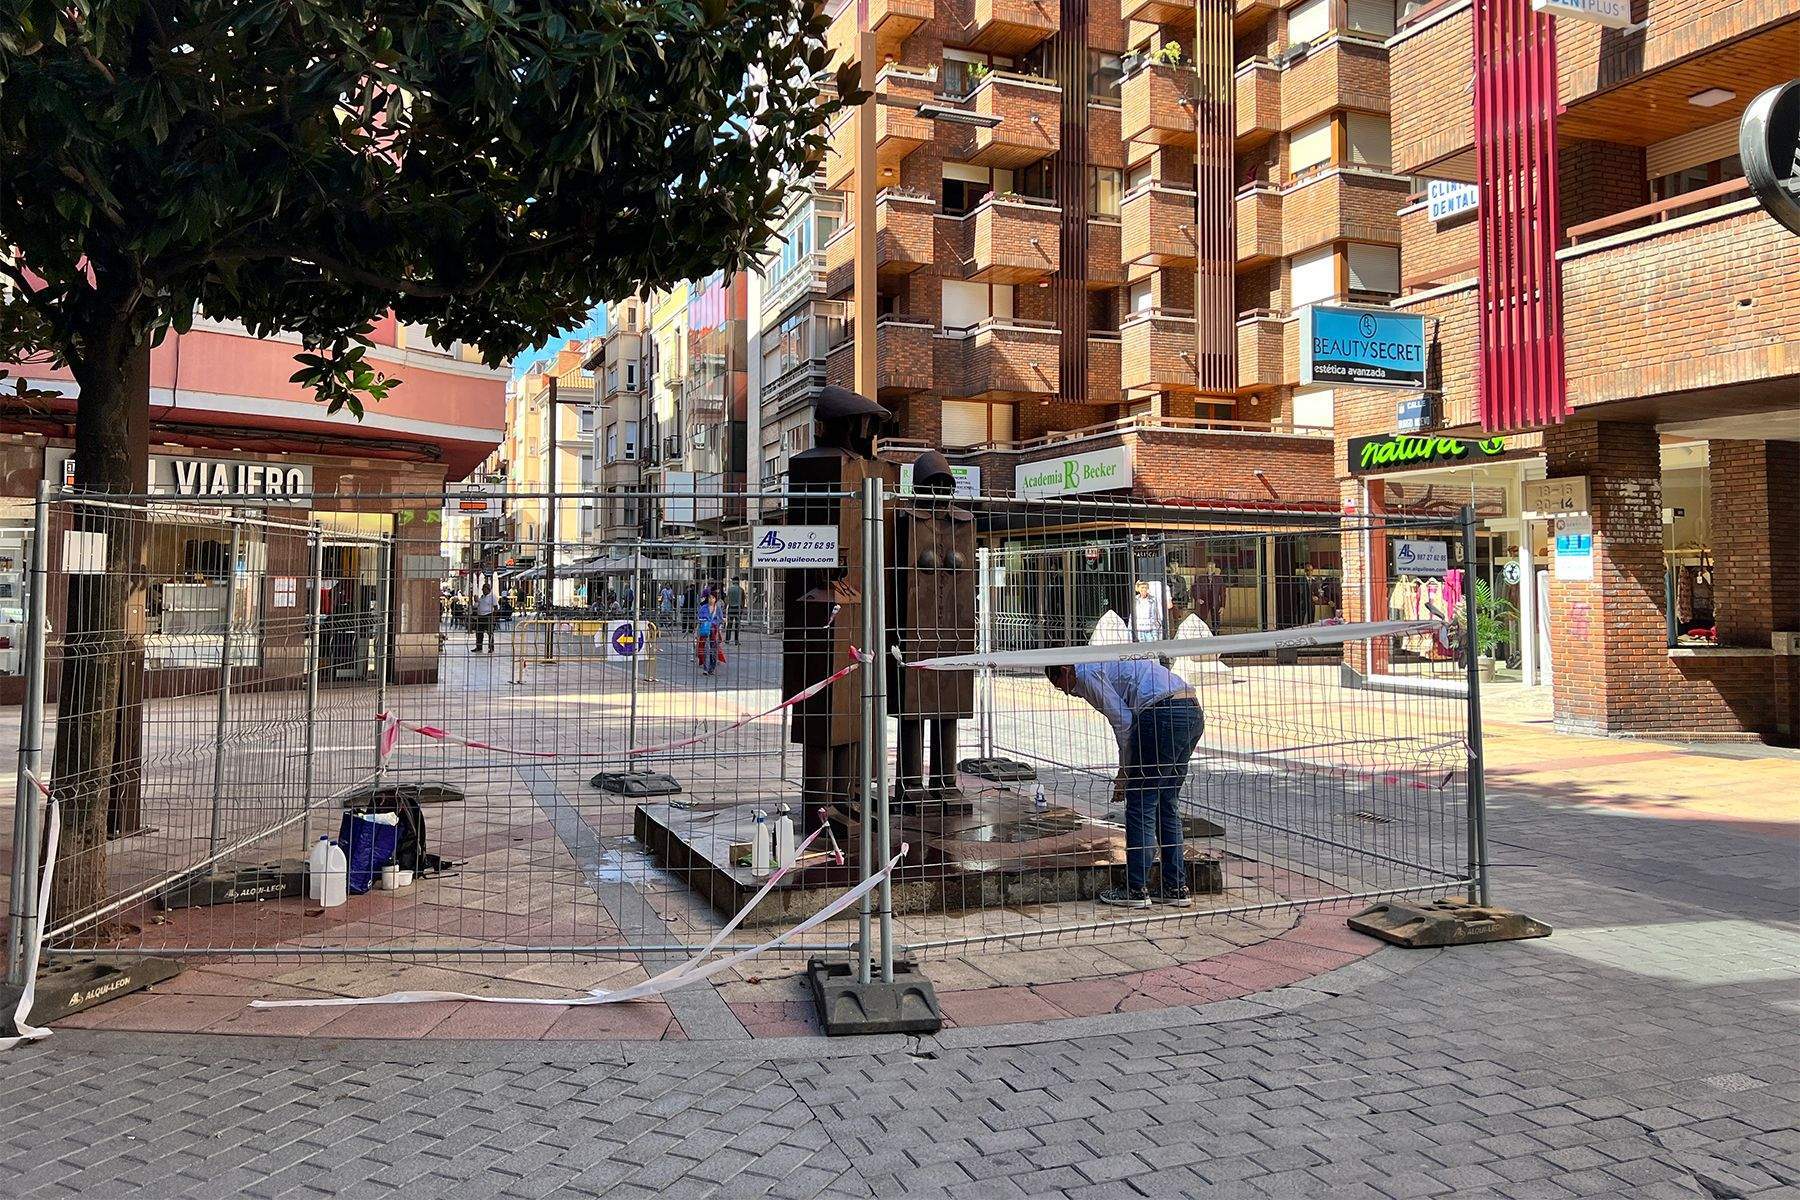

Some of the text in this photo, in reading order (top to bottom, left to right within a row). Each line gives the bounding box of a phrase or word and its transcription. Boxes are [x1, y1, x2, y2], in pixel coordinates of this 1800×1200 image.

[1433, 190, 1477, 217] DENTAL
[1313, 337, 1422, 361] BEAUTYSECRET
[1314, 364, 1386, 378] estética avanzada
[1361, 434, 1466, 468] natura
[148, 459, 304, 504] L VIAJERO
[1023, 470, 1063, 489] Academia
[1083, 463, 1117, 480] Becker
[787, 541, 801, 550] 987
[803, 541, 813, 550] 27
[814, 541, 824, 550] 62
[825, 541, 835, 550] 95
[757, 556, 834, 564] www.alquileon.com
[85, 977, 131, 1001] ALQUI-LEON
